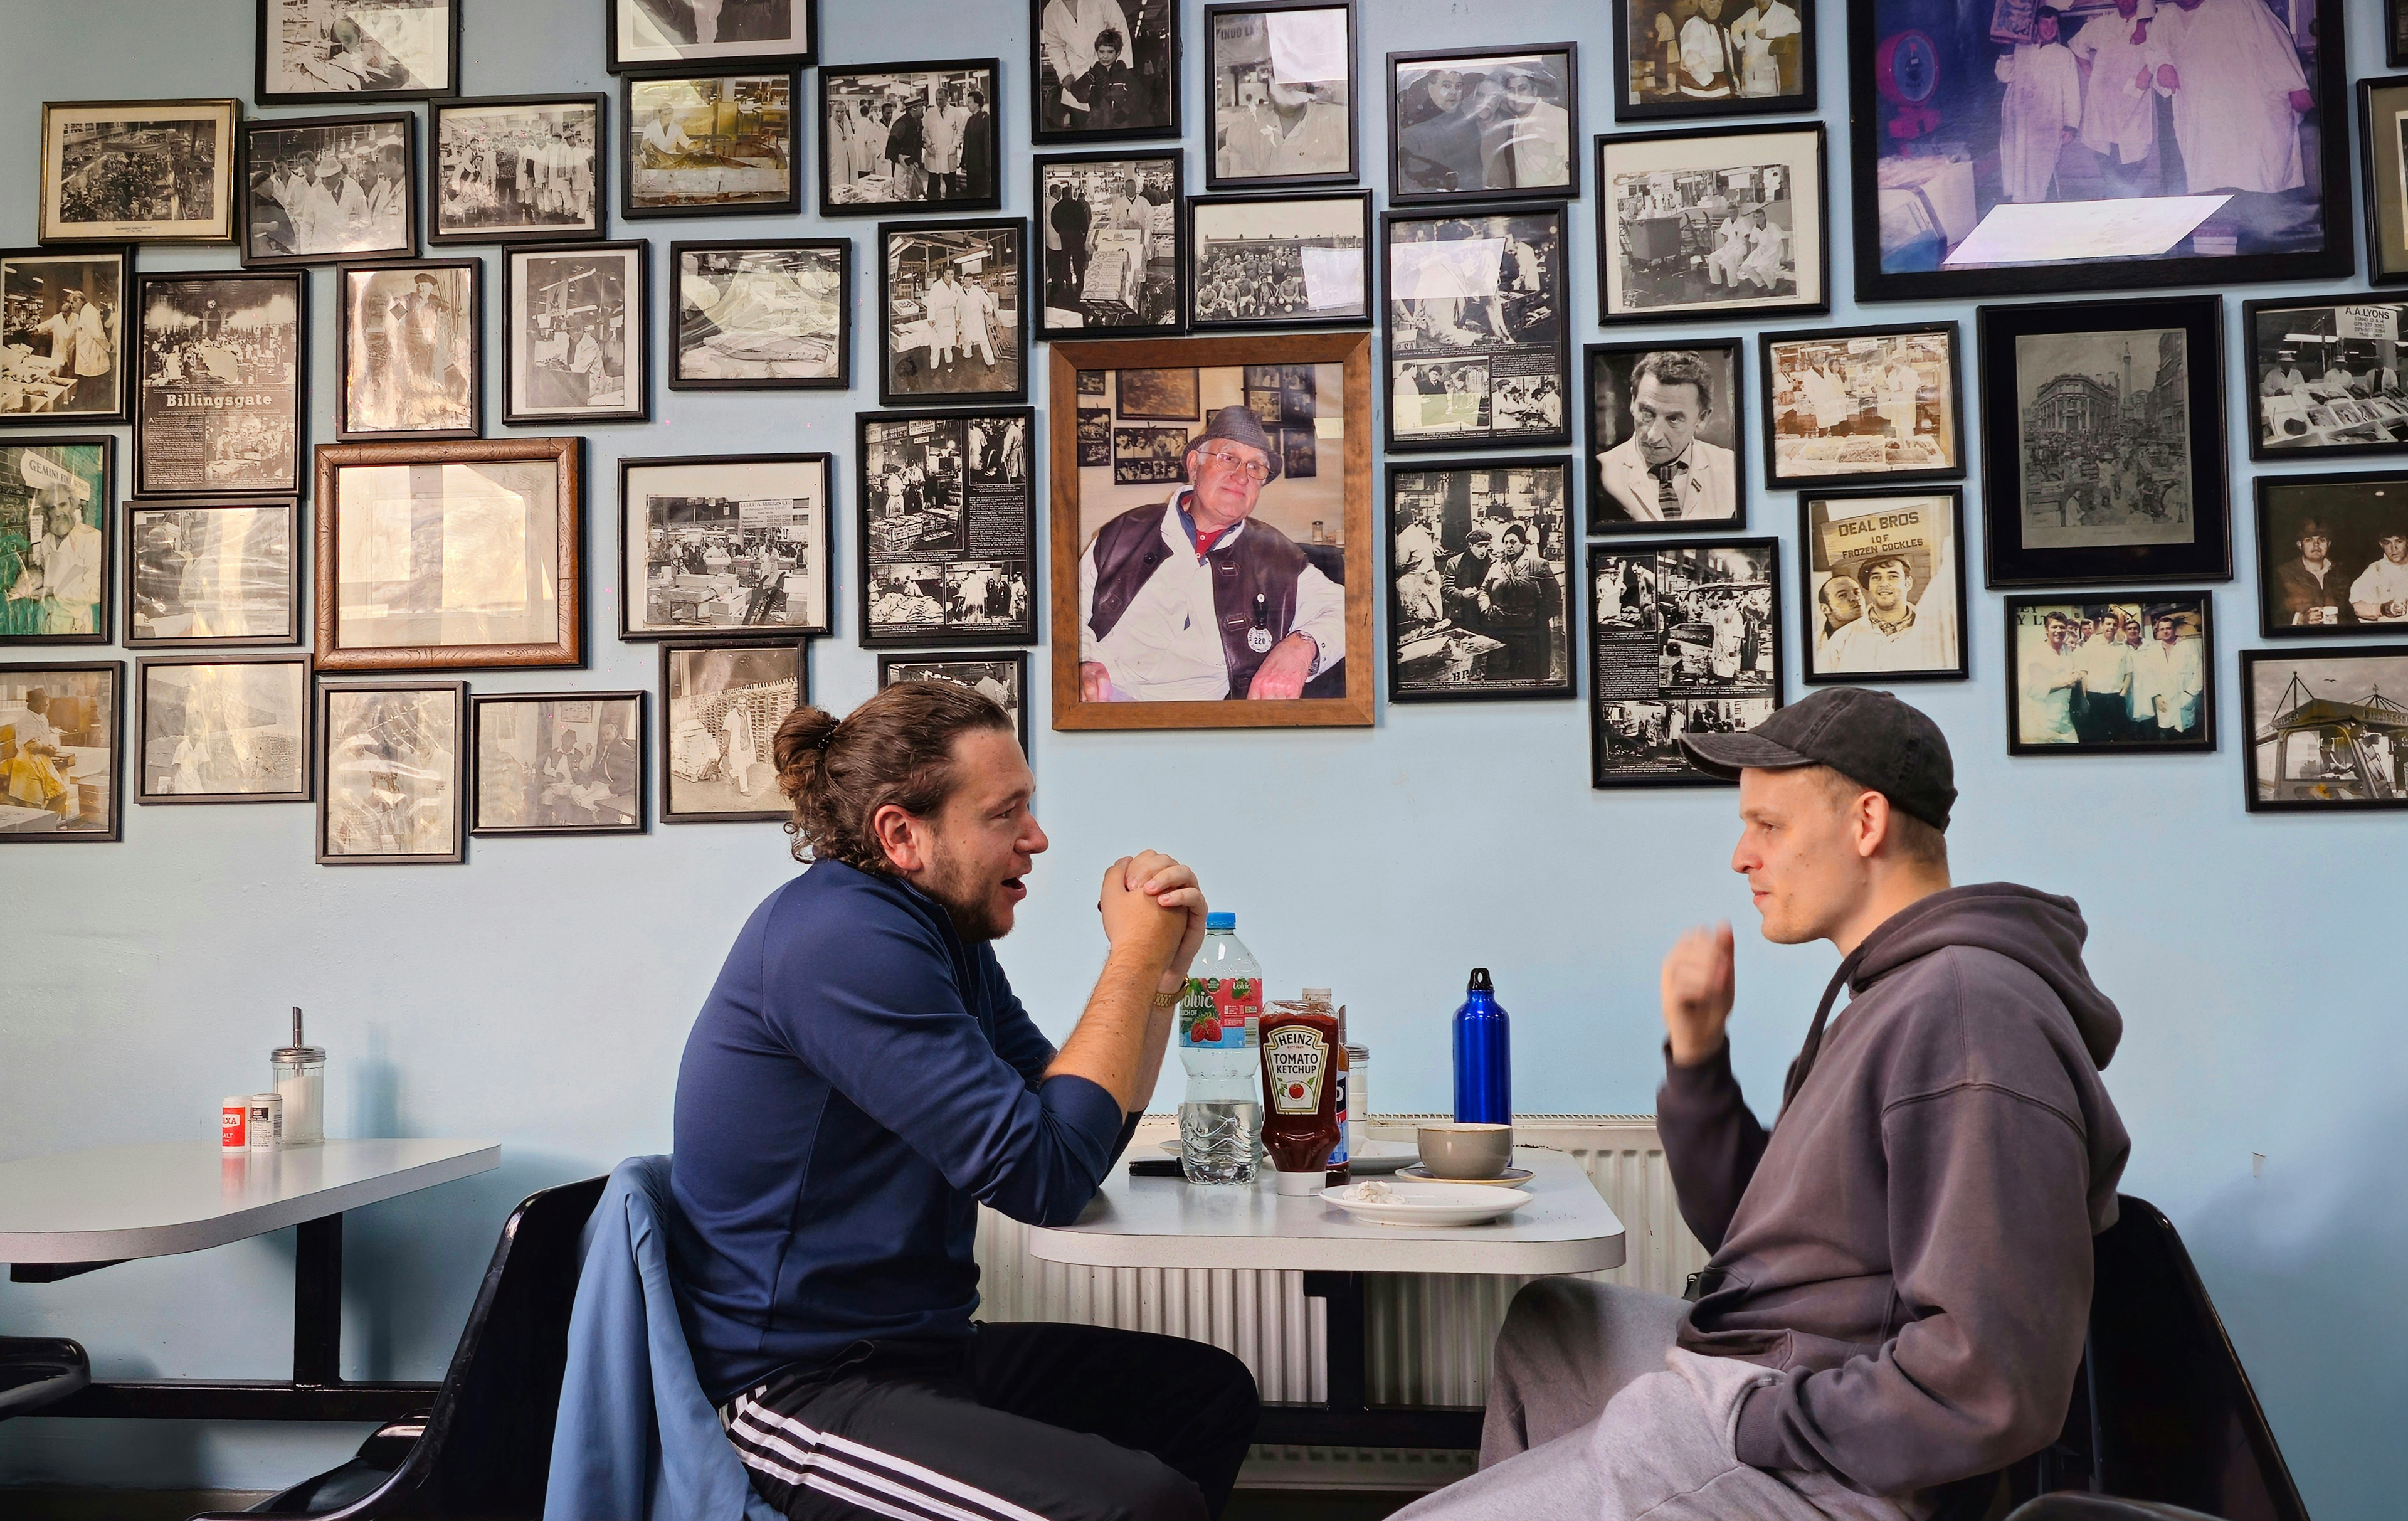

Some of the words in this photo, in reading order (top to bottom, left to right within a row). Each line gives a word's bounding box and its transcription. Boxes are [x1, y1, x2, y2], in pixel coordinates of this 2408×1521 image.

[2345, 307, 2390, 320] A.A.LYONS
[166, 393, 272, 408] Billingsgate
[29, 460, 59, 481] GEMINI
[1839, 520, 1876, 537] DEAL
[1842, 546, 1878, 559] FROZEN
[1882, 538, 1923, 552] COCKLES
[1278, 1033, 1313, 1046] HEINZ
[1274, 1053, 1318, 1064] TOMATO
[1277, 1065, 1317, 1074] KETCHUP
